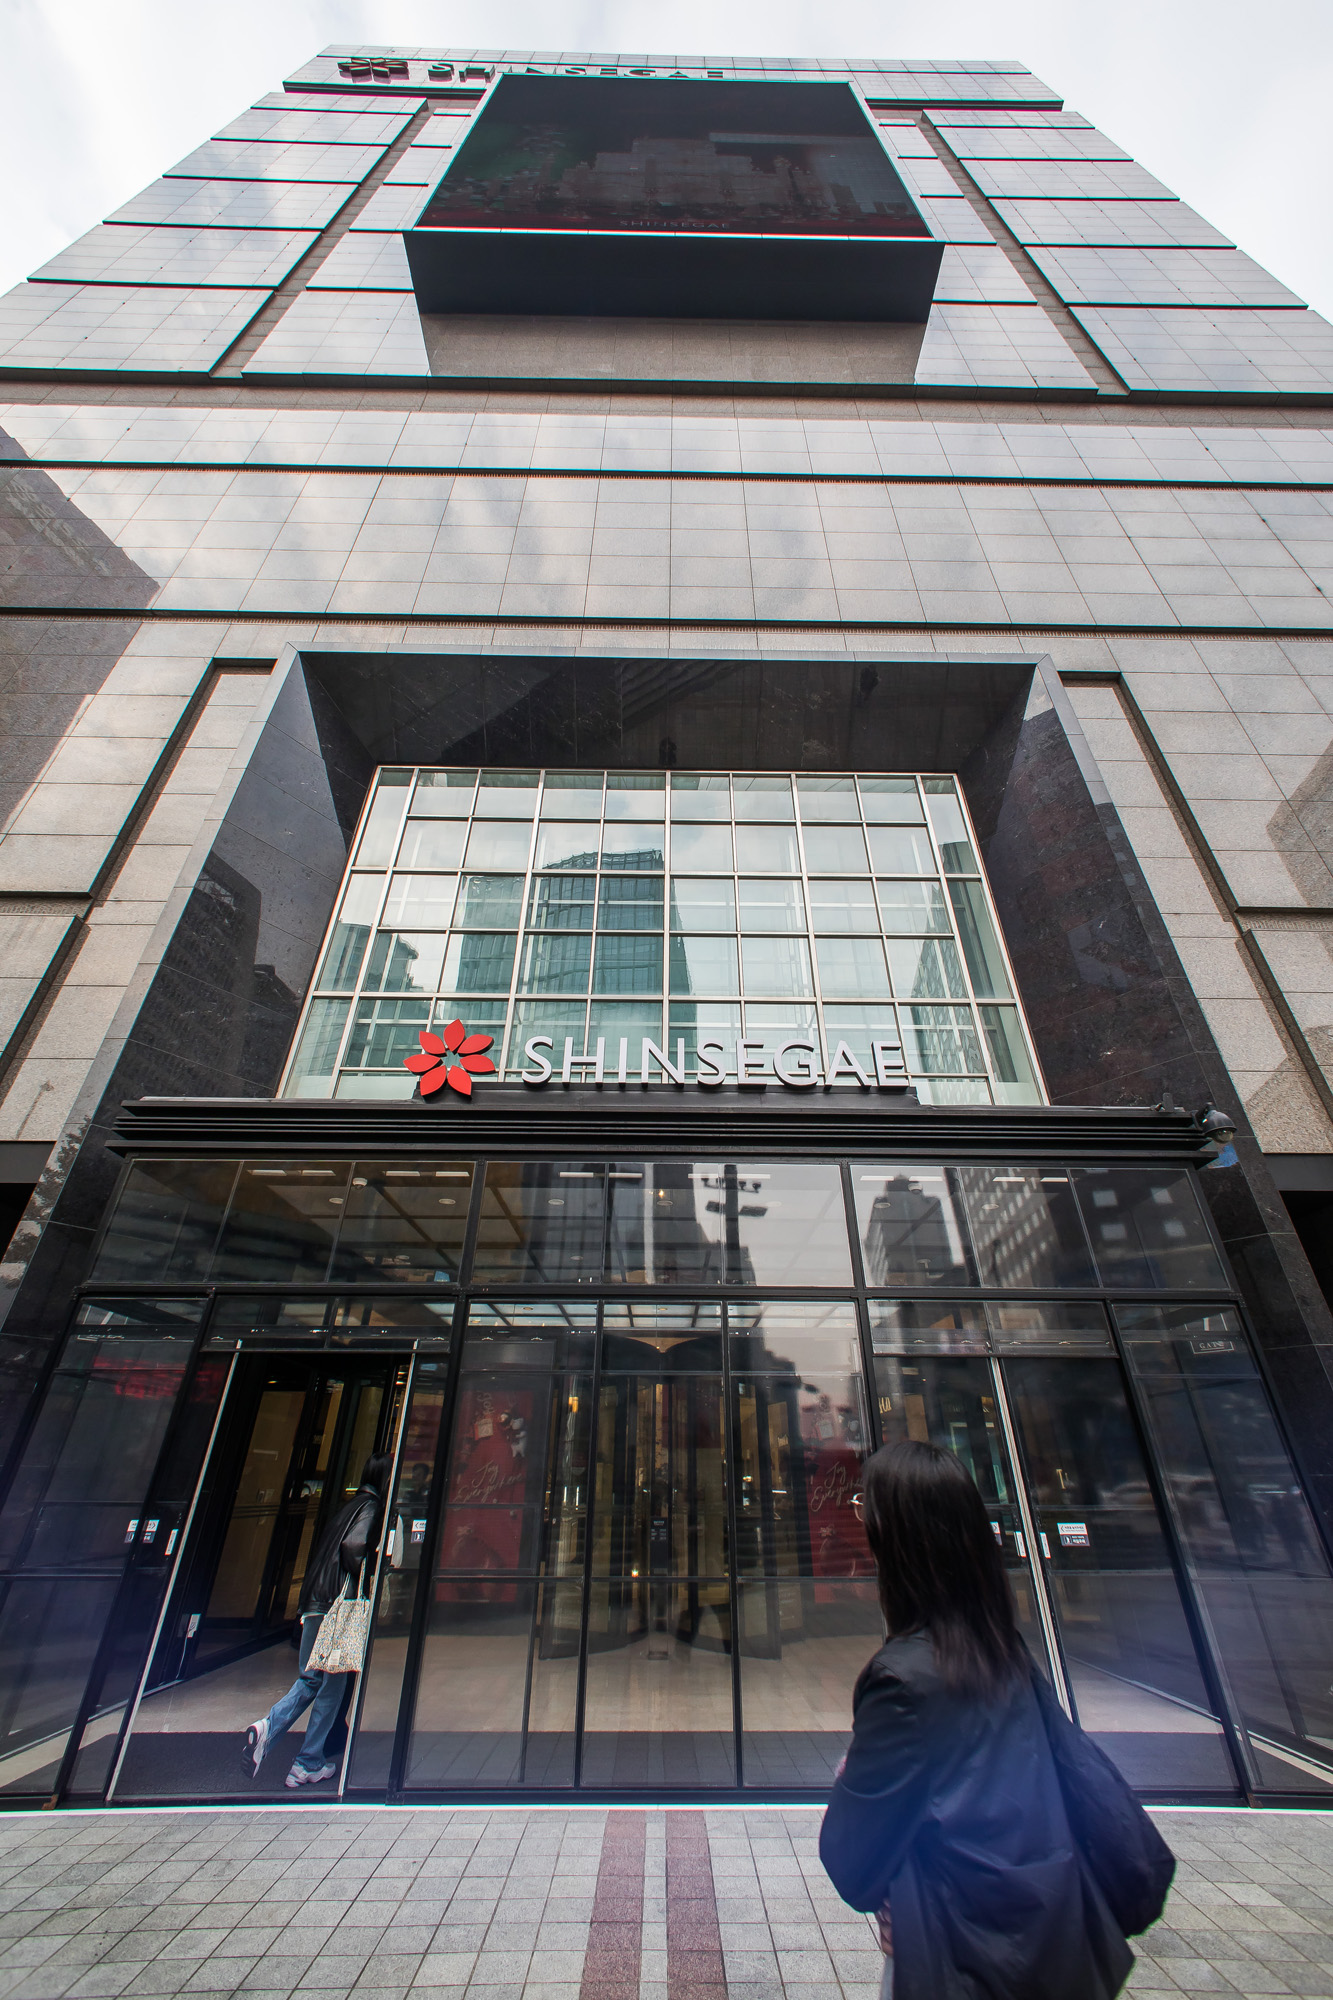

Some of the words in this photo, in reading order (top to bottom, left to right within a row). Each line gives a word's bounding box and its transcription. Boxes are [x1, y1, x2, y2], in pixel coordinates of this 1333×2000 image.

[619, 219, 730, 230] SHINSEGAE
[520, 1035, 910, 1089] SHINSEGAE
[471, 1459, 499, 1488] Joy
[823, 1460, 847, 1489] Joy
